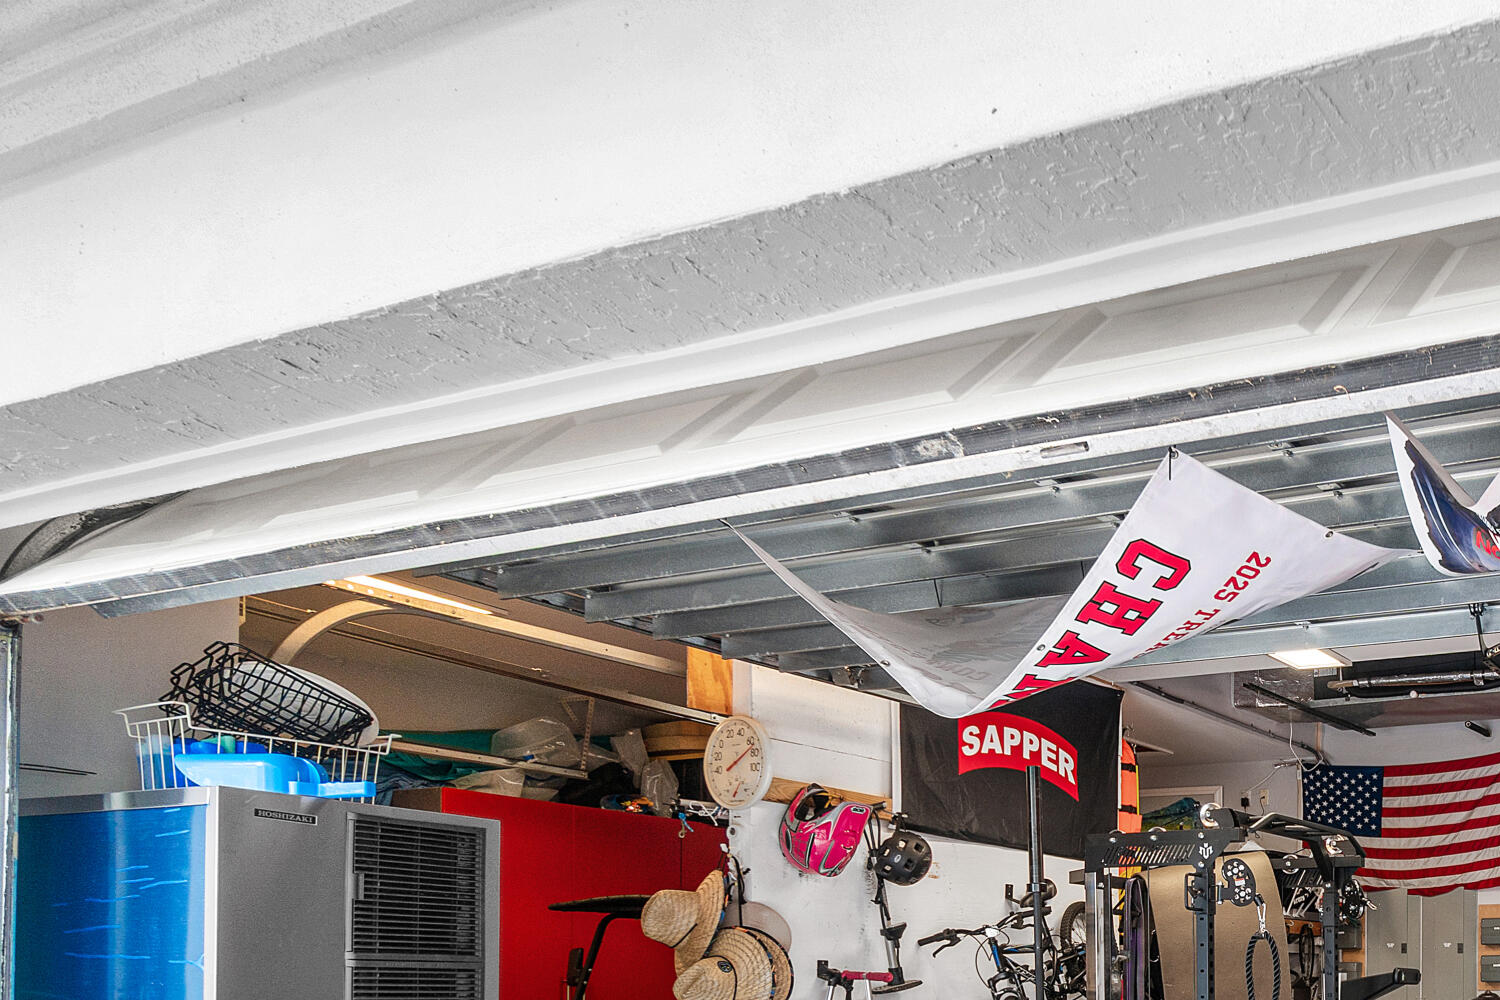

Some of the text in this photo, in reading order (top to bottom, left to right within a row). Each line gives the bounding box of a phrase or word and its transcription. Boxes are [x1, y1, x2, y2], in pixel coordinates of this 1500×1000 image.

[1213, 551, 1272, 603] 2025
[726, 729, 735, 739] 20
[736, 727, 745, 737] 40
[961, 724, 1076, 786] SAPPER
[750, 762, 761, 772] 100
[258, 810, 313, 823] HOSHIZAKI
